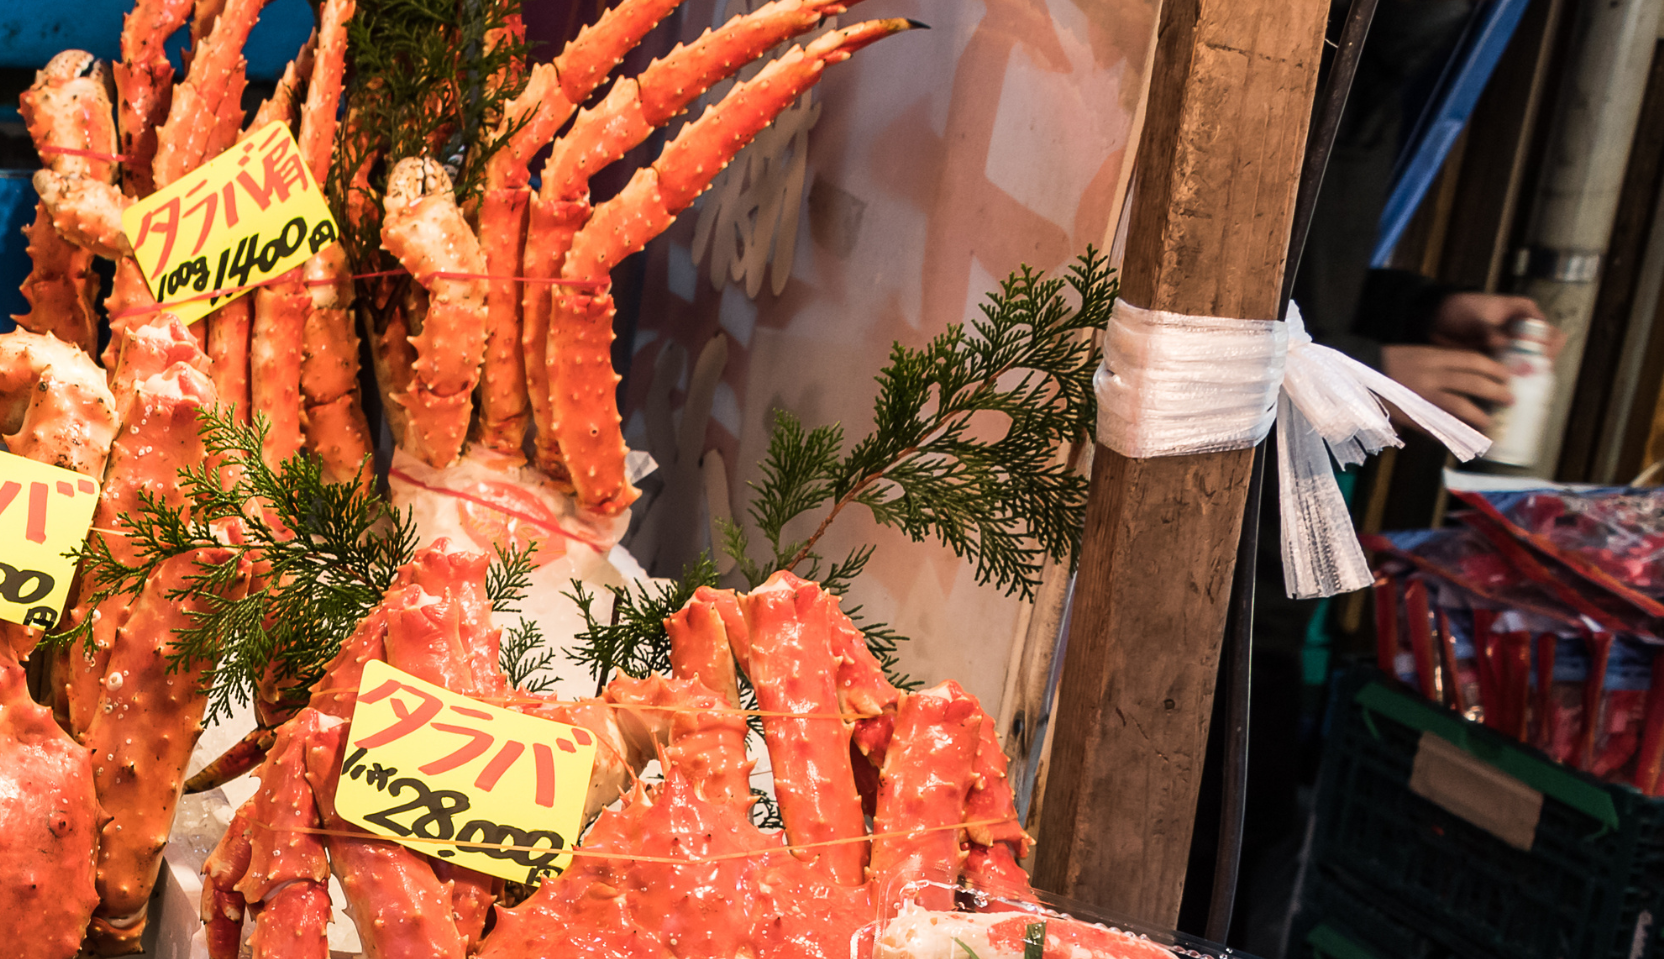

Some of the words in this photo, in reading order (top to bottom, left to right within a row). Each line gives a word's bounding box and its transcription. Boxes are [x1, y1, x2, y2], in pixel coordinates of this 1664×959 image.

[134, 127, 309, 281] タラバ肩
[353, 679, 593, 808] タラバ
